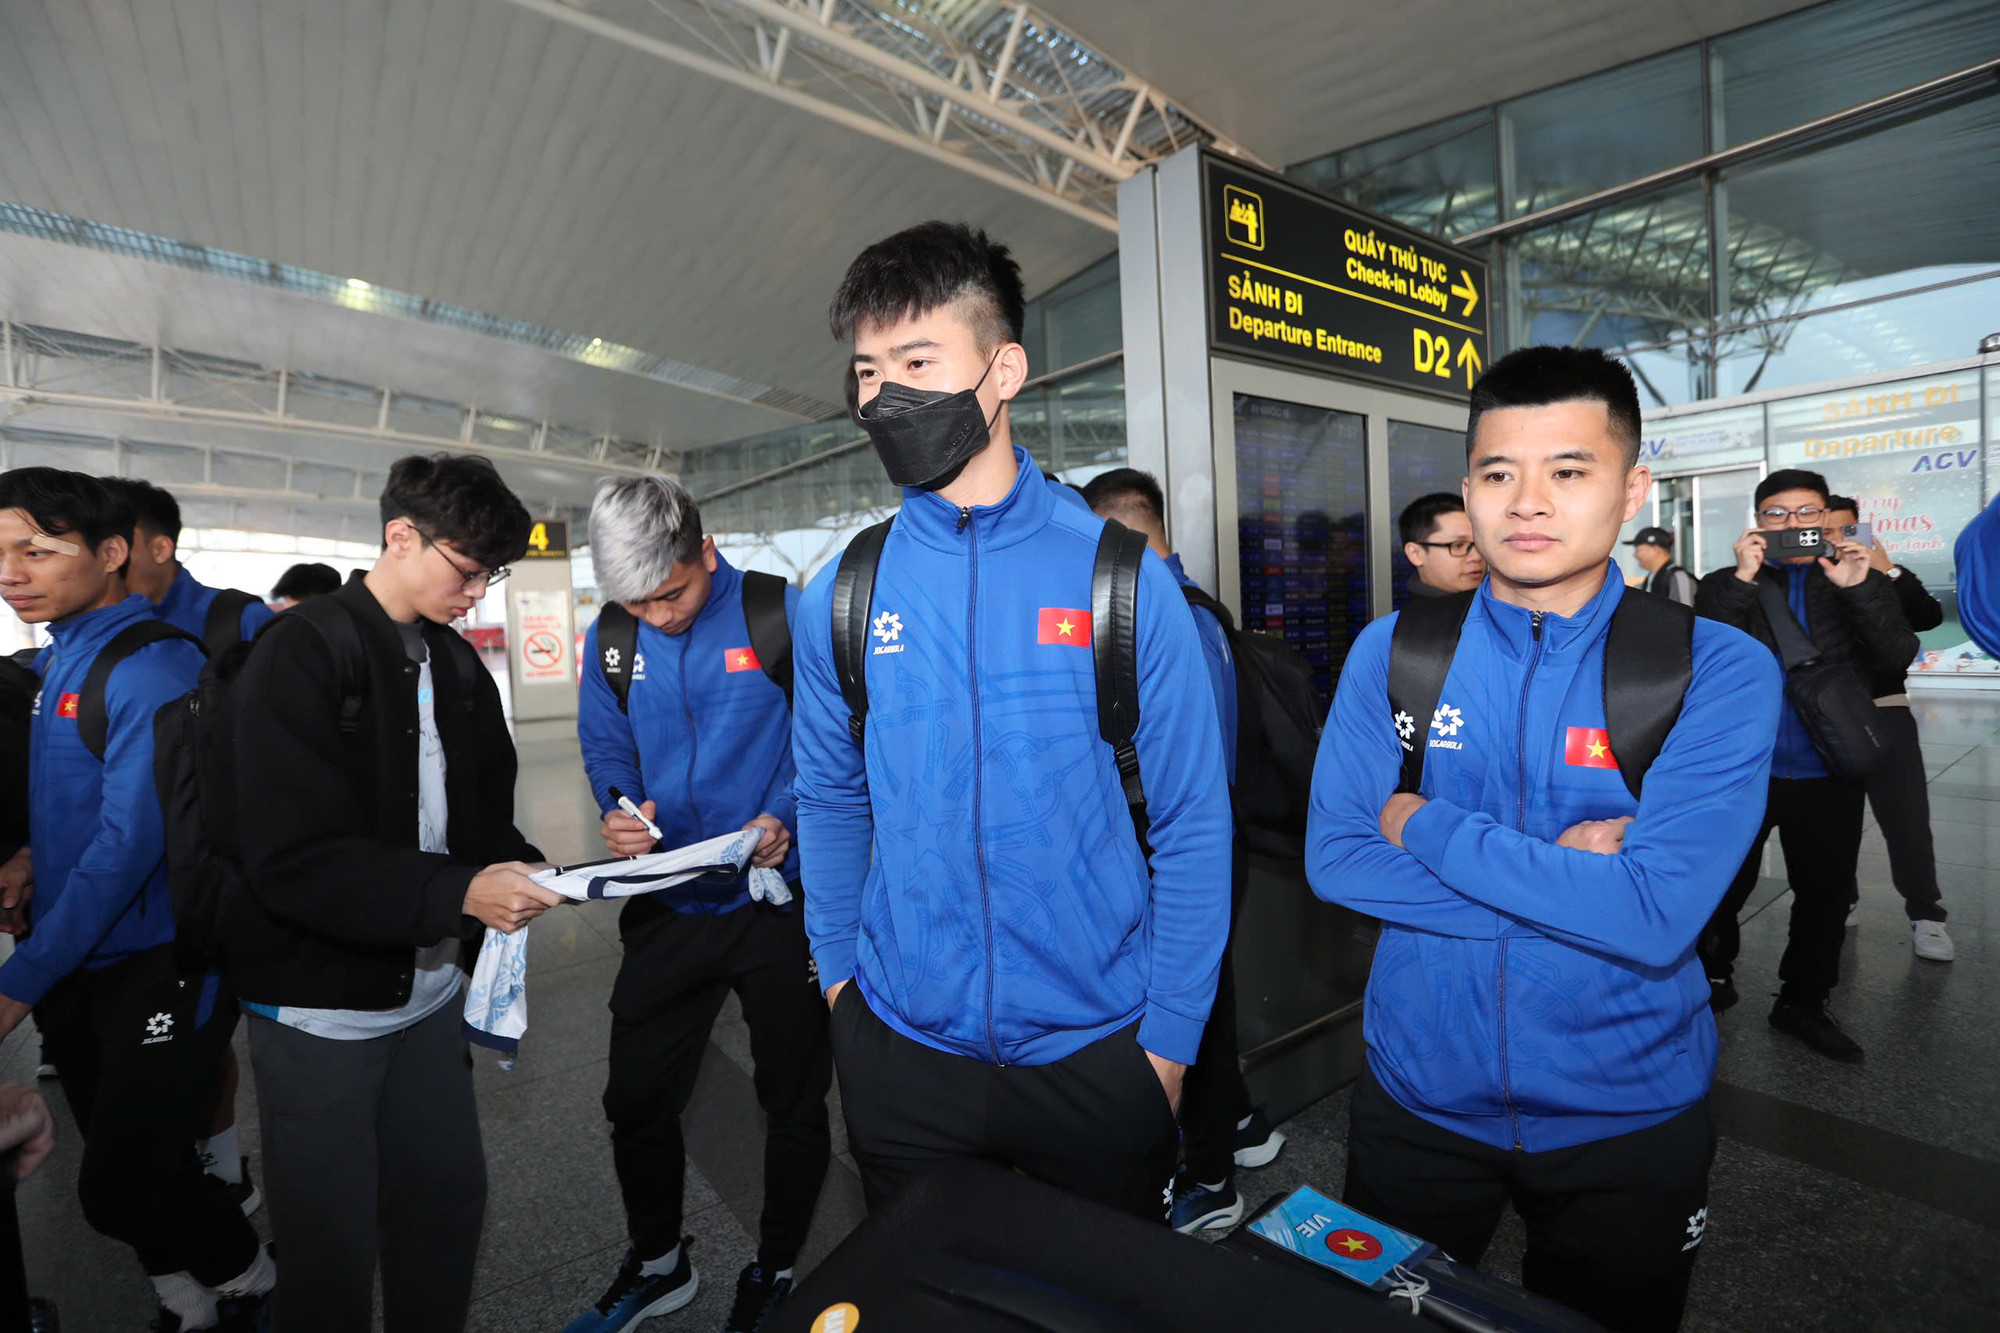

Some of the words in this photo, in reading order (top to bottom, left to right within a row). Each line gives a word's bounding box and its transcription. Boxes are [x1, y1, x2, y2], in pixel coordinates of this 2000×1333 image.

[1389, 245, 1418, 274] THỦ
[1420, 256, 1448, 284] TỤC
[1228, 270, 1281, 310] SẢNH
[1285, 290, 1303, 316] ĐI
[1346, 257, 1408, 296] Check-in
[1409, 278, 1448, 313] Lobby
[1229, 306, 1313, 348] Departure
[1316, 328, 1383, 364] Entrance
[1413, 327, 1451, 379] D2
[1925, 383, 1960, 407] ĐI
[1805, 425, 1959, 457] Departure
[1911, 450, 1977, 473] ACV
[529, 522, 549, 551] 4
[1295, 1213, 1332, 1238] VIE
